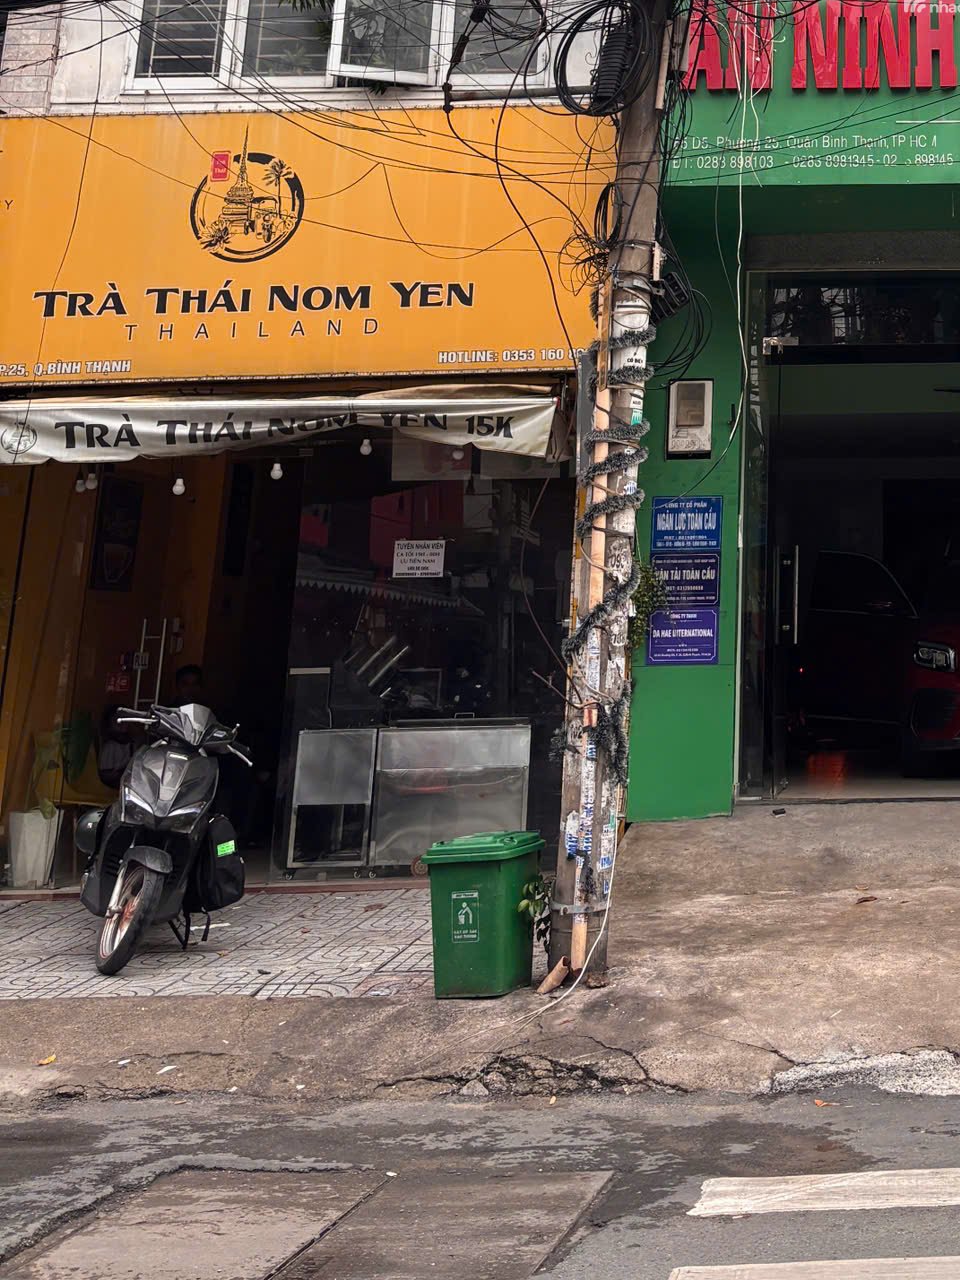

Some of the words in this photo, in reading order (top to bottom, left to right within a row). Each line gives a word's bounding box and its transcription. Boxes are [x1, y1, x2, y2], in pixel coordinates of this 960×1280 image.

[33, 282, 127, 319] TRÀ
[146, 280, 252, 315] THÁI
[267, 285, 372, 312] NOM
[388, 281, 475, 309] YEN
[124, 318, 380, 342] THAILAND
[34, 359, 81, 377] Q.BÌNH
[85, 360, 131, 375] THẠNH
[438, 351, 499, 364] HOTLINE:
[502, 349, 535, 362] 0353
[540, 348, 564, 361] 160
[54, 414, 141, 448] TRÀ
[157, 412, 252, 445] THÁI
[465, 415, 516, 439] 15K
